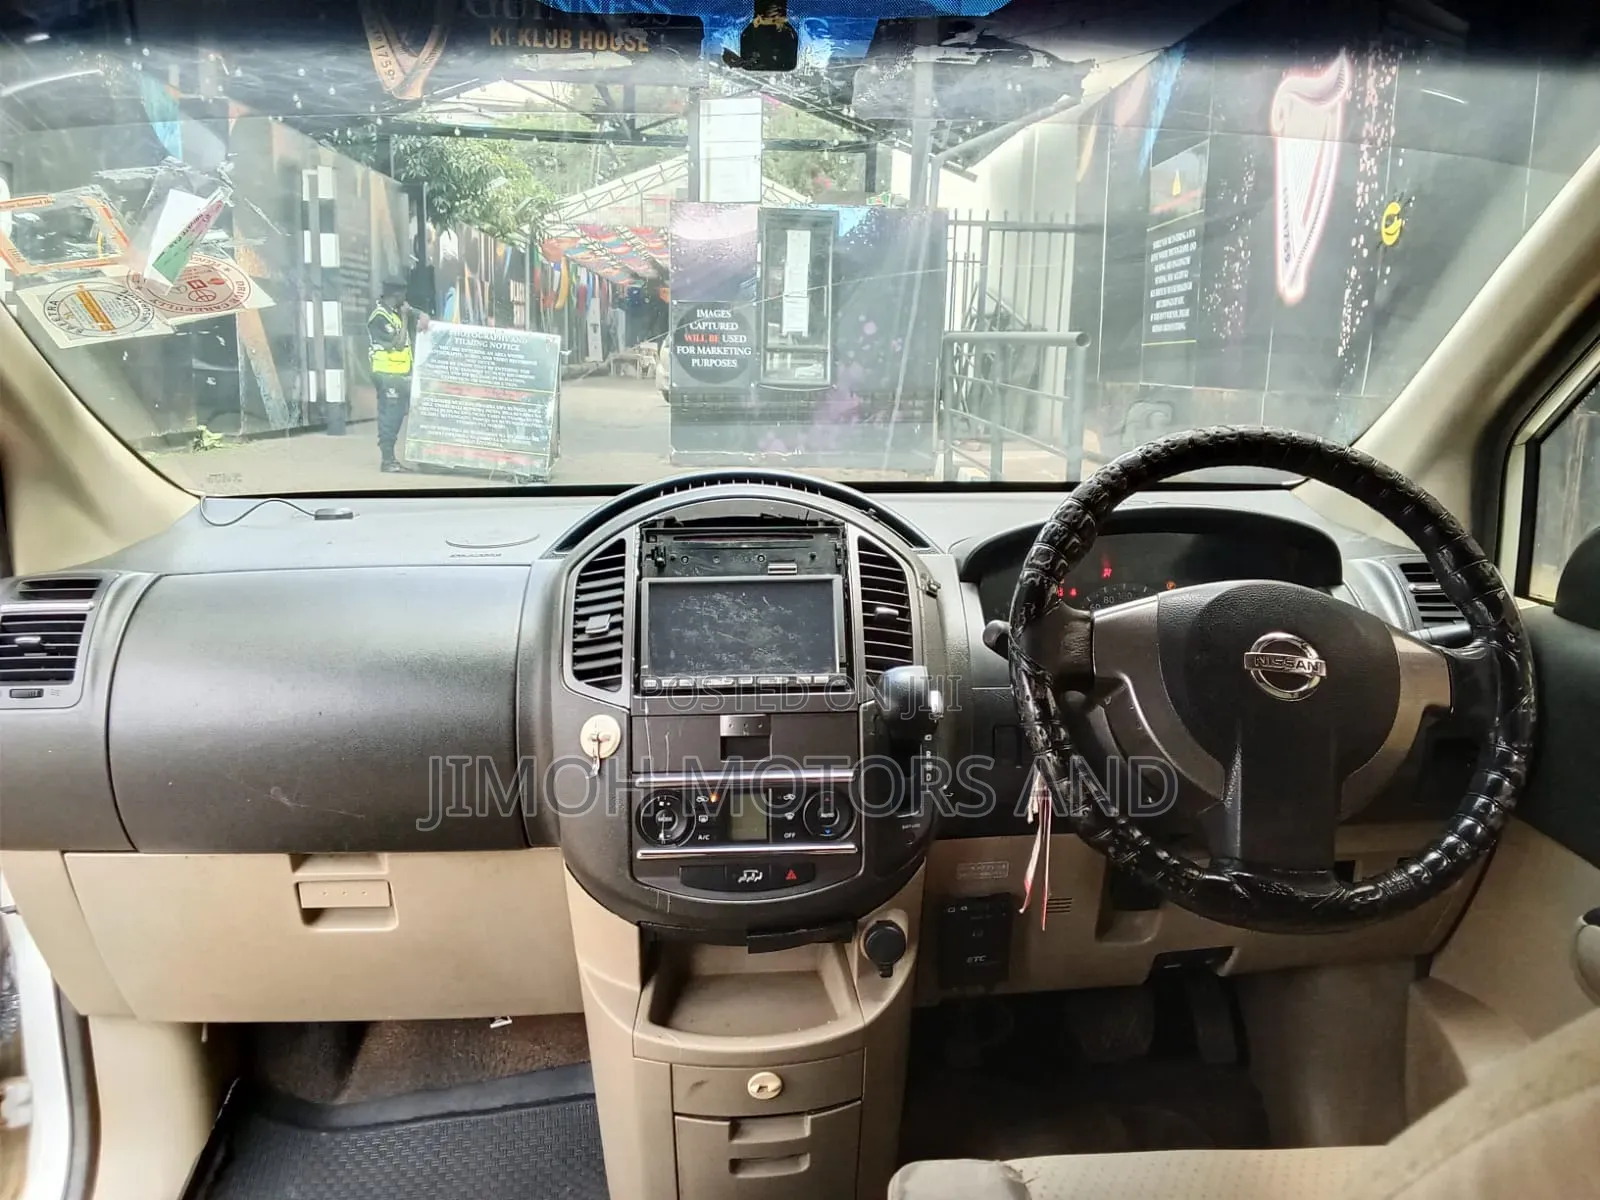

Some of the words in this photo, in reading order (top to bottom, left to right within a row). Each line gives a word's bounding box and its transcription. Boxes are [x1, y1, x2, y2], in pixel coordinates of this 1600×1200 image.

[518, 28, 572, 49] KLUB
[579, 29, 649, 52] HOUSE
[696, 309, 732, 318] IMAGES
[689, 321, 739, 330] CAPTURED
[722, 334, 747, 343] USED
[489, 342, 521, 351] NOTICE
[676, 346, 695, 354] FOR
[696, 346, 752, 355] MARKETING
[691, 358, 738, 368] PURPOSES
[1103, 596, 1115, 604] 80
[1254, 656, 1319, 673] NISSAN
[697, 833, 710, 841] A/C
